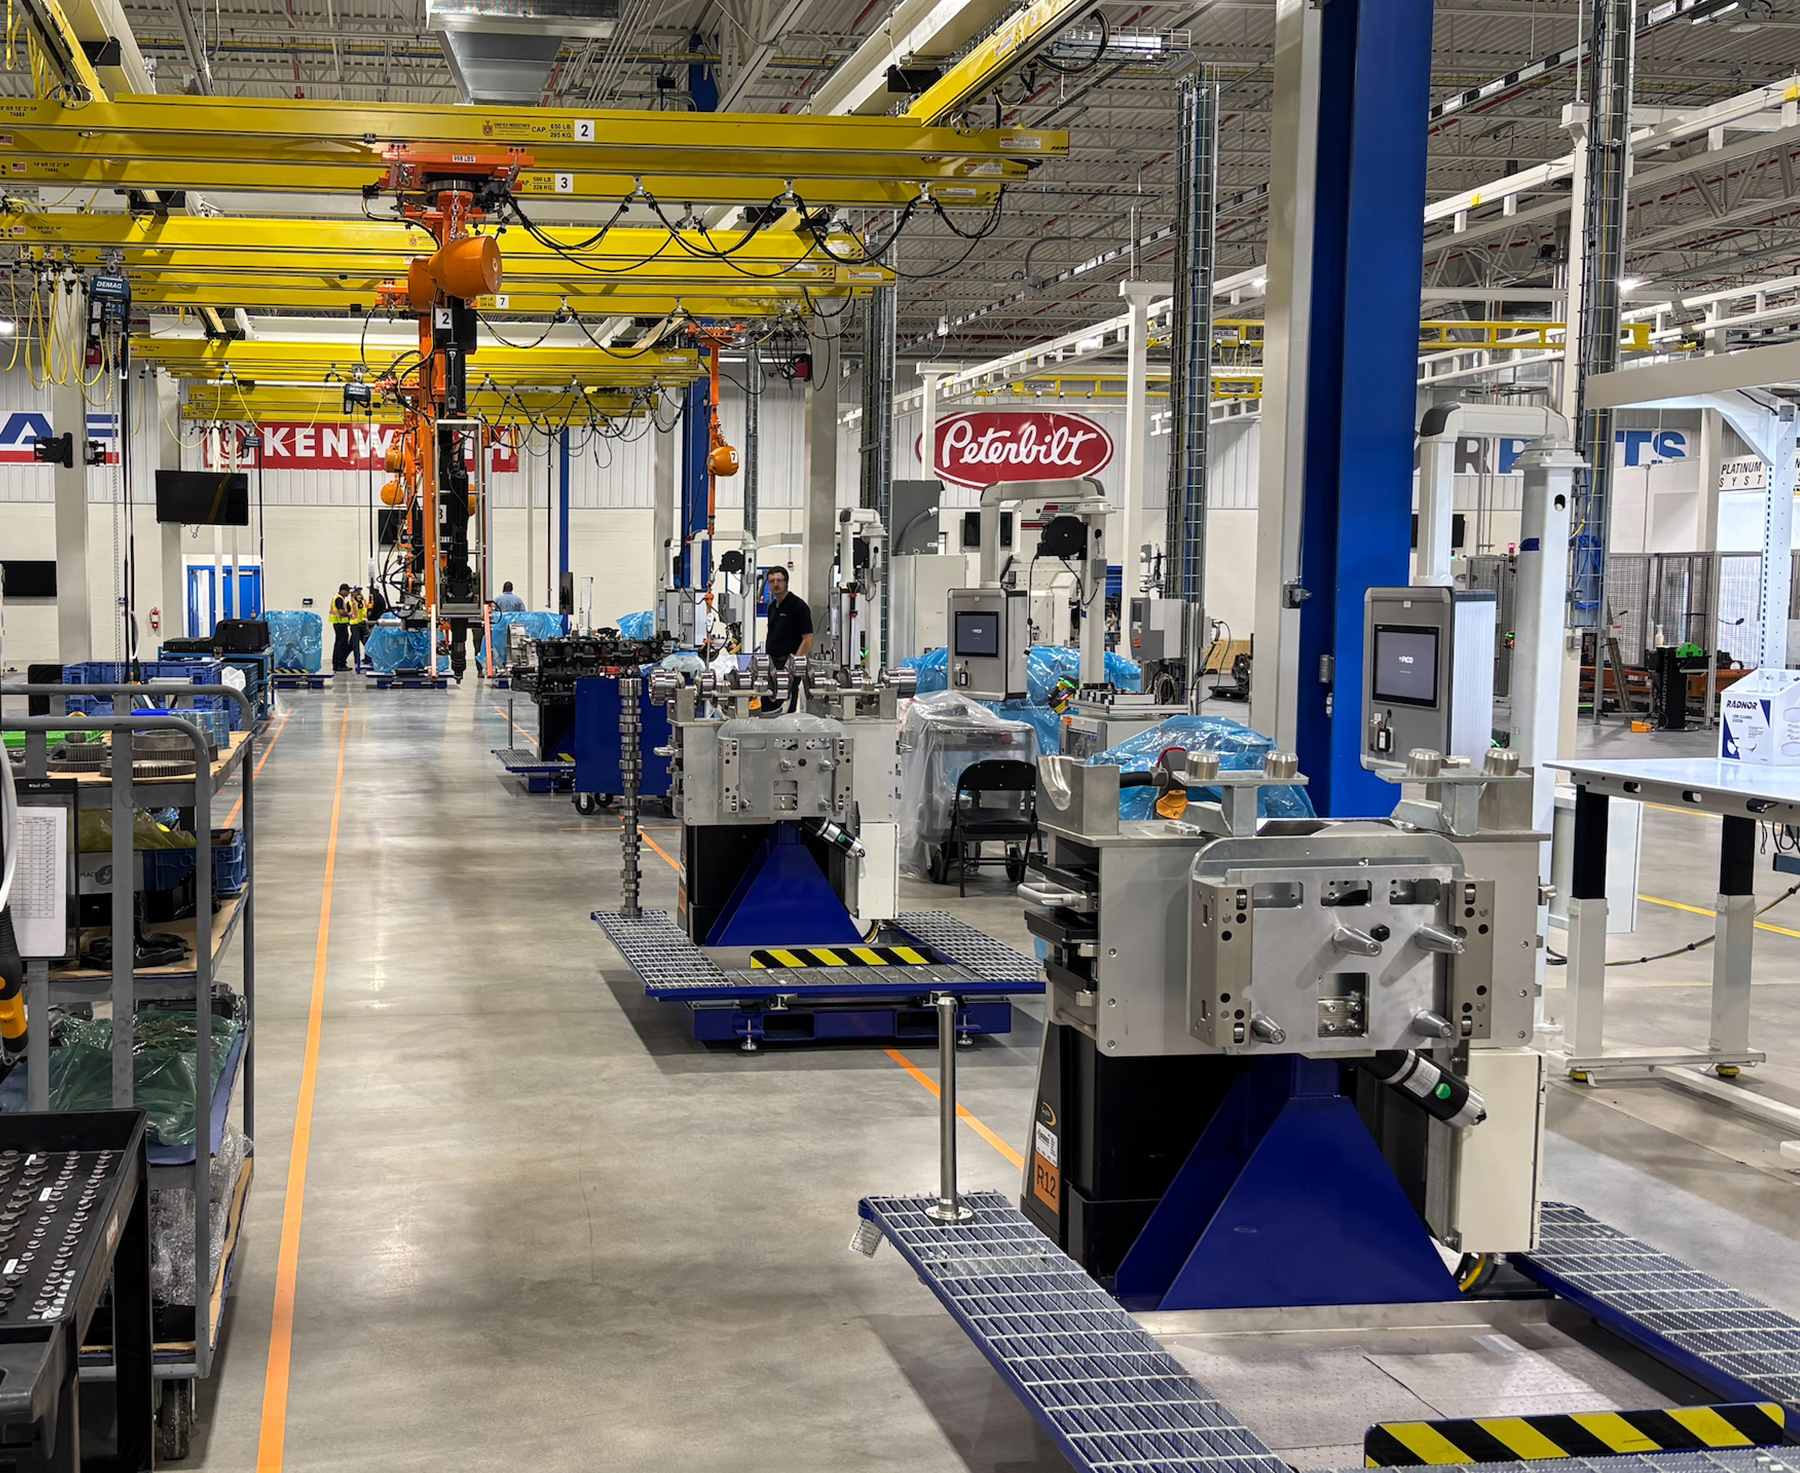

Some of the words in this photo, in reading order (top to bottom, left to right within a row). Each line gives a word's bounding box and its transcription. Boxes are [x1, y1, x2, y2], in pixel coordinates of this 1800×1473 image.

[580, 124, 589, 137] 2
[560, 177, 568, 189] 3
[96, 280, 123, 289] DEMAG
[500, 297, 506, 306] 7
[442, 312, 450, 325] 2
[265, 427, 510, 460] KENWTH
[942, 420, 1098, 468] Peterbilt
[1721, 461, 1762, 475] PLATINUM
[1718, 474, 1762, 488] SYST
[1401, 655, 1414, 664] PICO
[1726, 700, 1758, 710] RADNOR
[1037, 1164, 1056, 1200] R12
